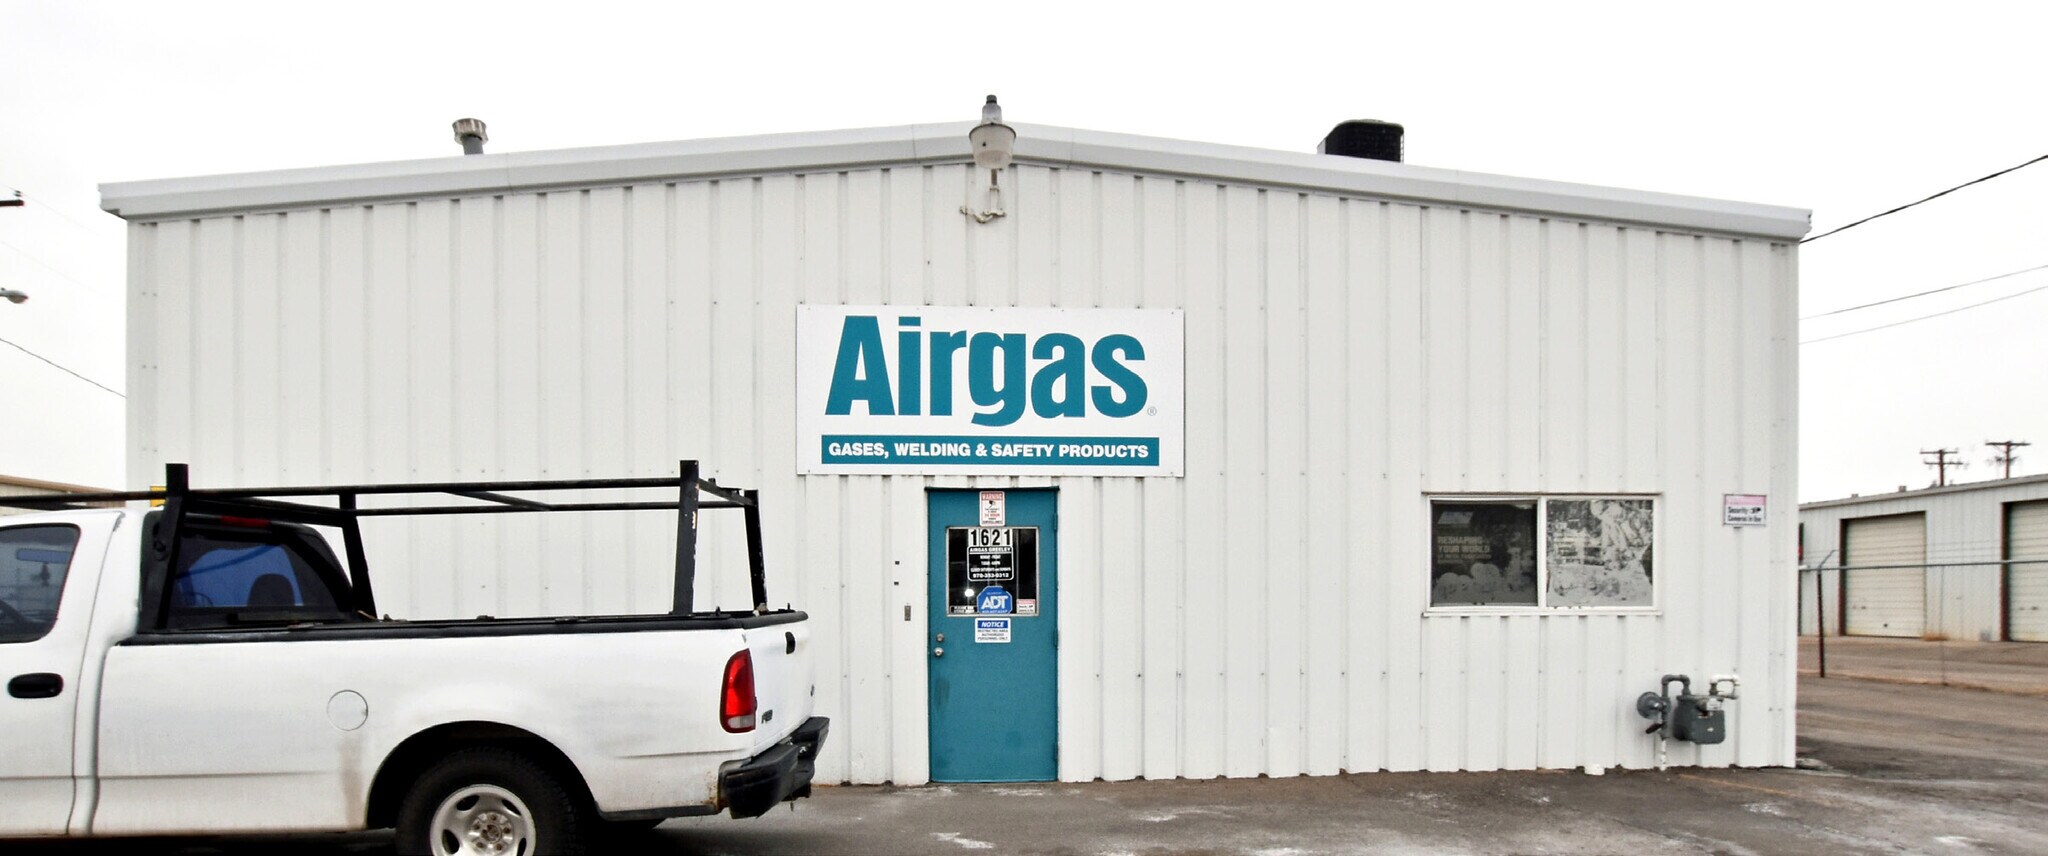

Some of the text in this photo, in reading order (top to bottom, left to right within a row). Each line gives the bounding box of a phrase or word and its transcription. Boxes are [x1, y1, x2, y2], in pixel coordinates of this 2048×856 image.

[825, 315, 1148, 427] Airgas
[828, 442, 1149, 460] GASES, WELDING & SAFETY PRODUCTS
[971, 529, 1010, 545] 1621
[981, 595, 1009, 610] ADT
